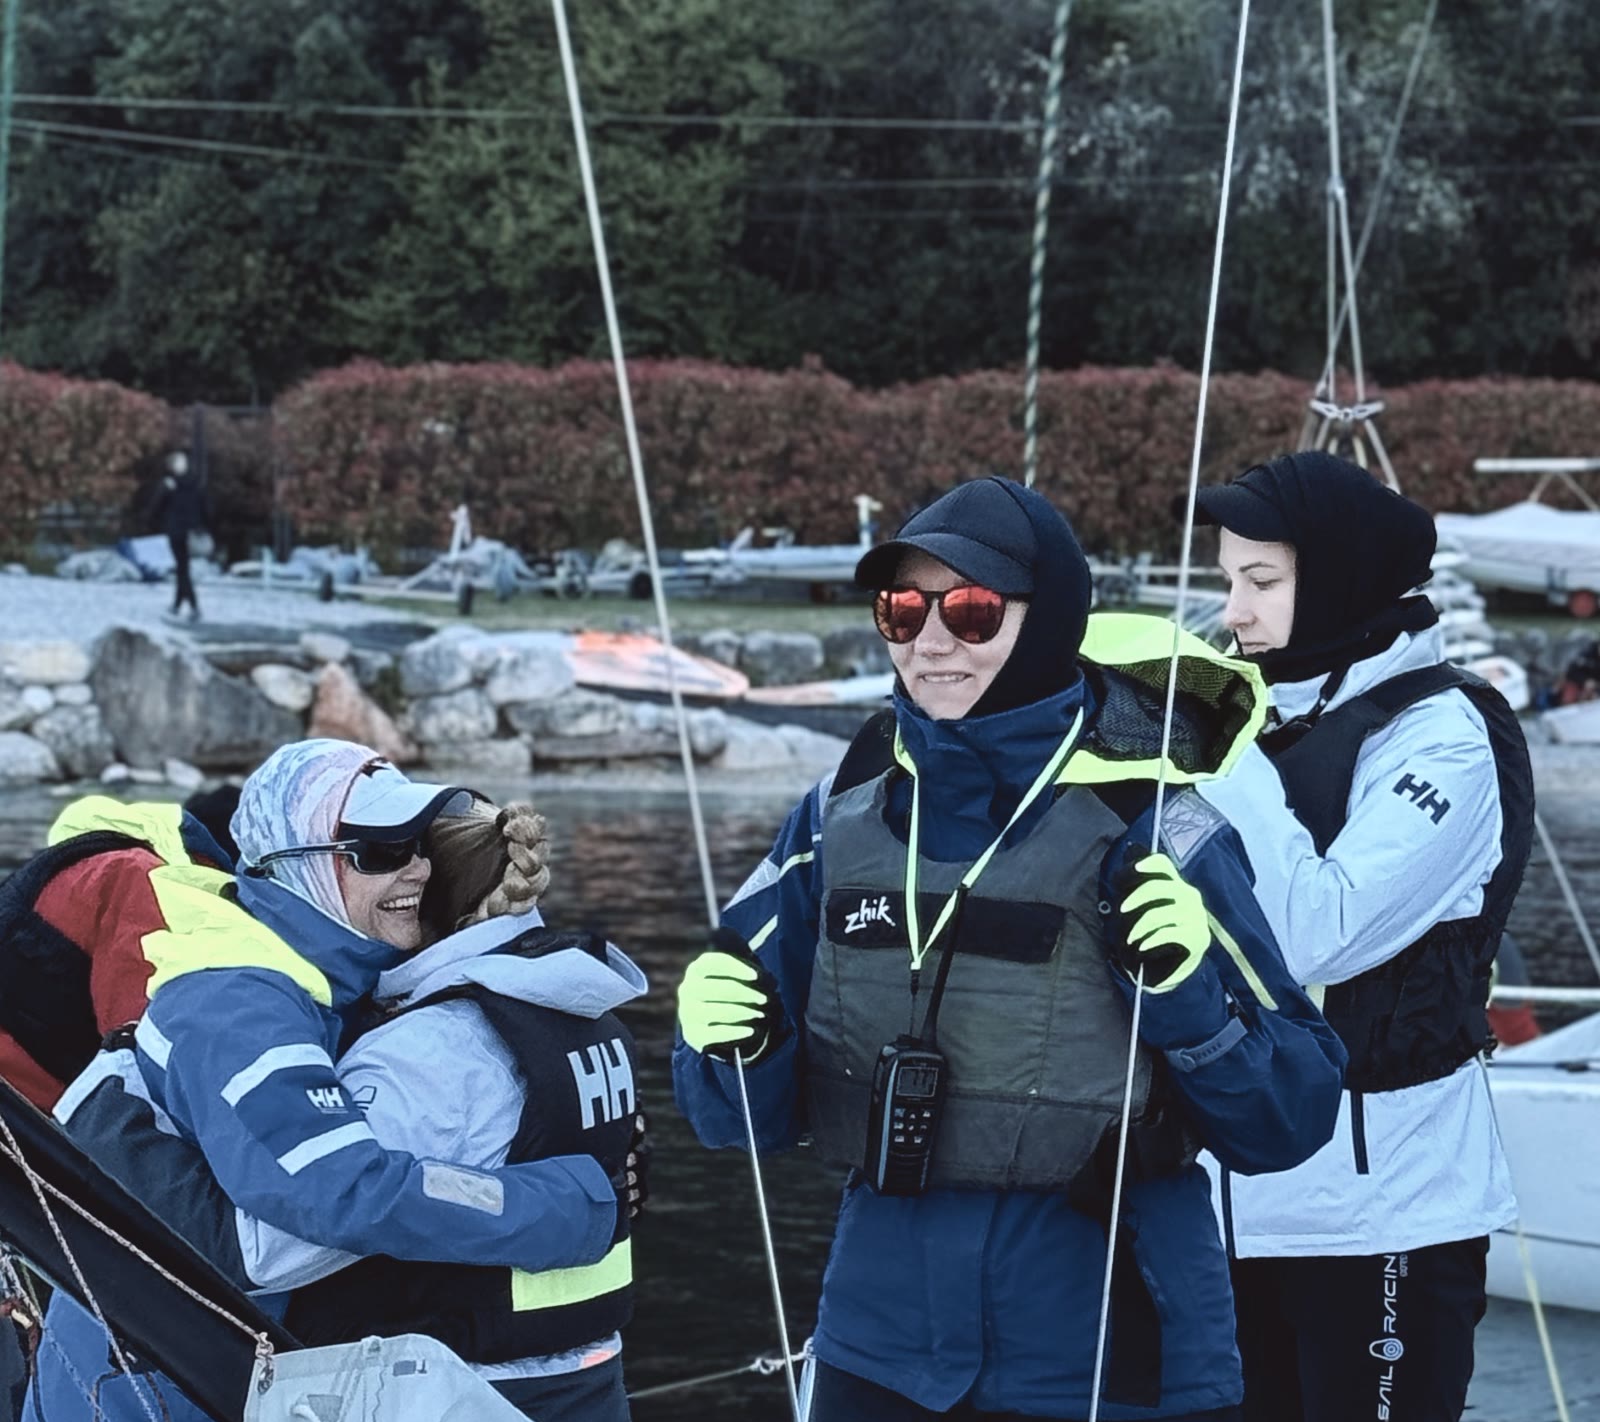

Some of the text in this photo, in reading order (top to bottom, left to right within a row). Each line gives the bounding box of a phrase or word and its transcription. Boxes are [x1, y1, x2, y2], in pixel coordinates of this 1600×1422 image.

[1392, 772, 1452, 826] HH
[844, 896, 894, 934] zhik
[306, 1087, 346, 1108] HH
[566, 1038, 635, 1130] HH
[1378, 1255, 1397, 1422] SAIL RACIN
